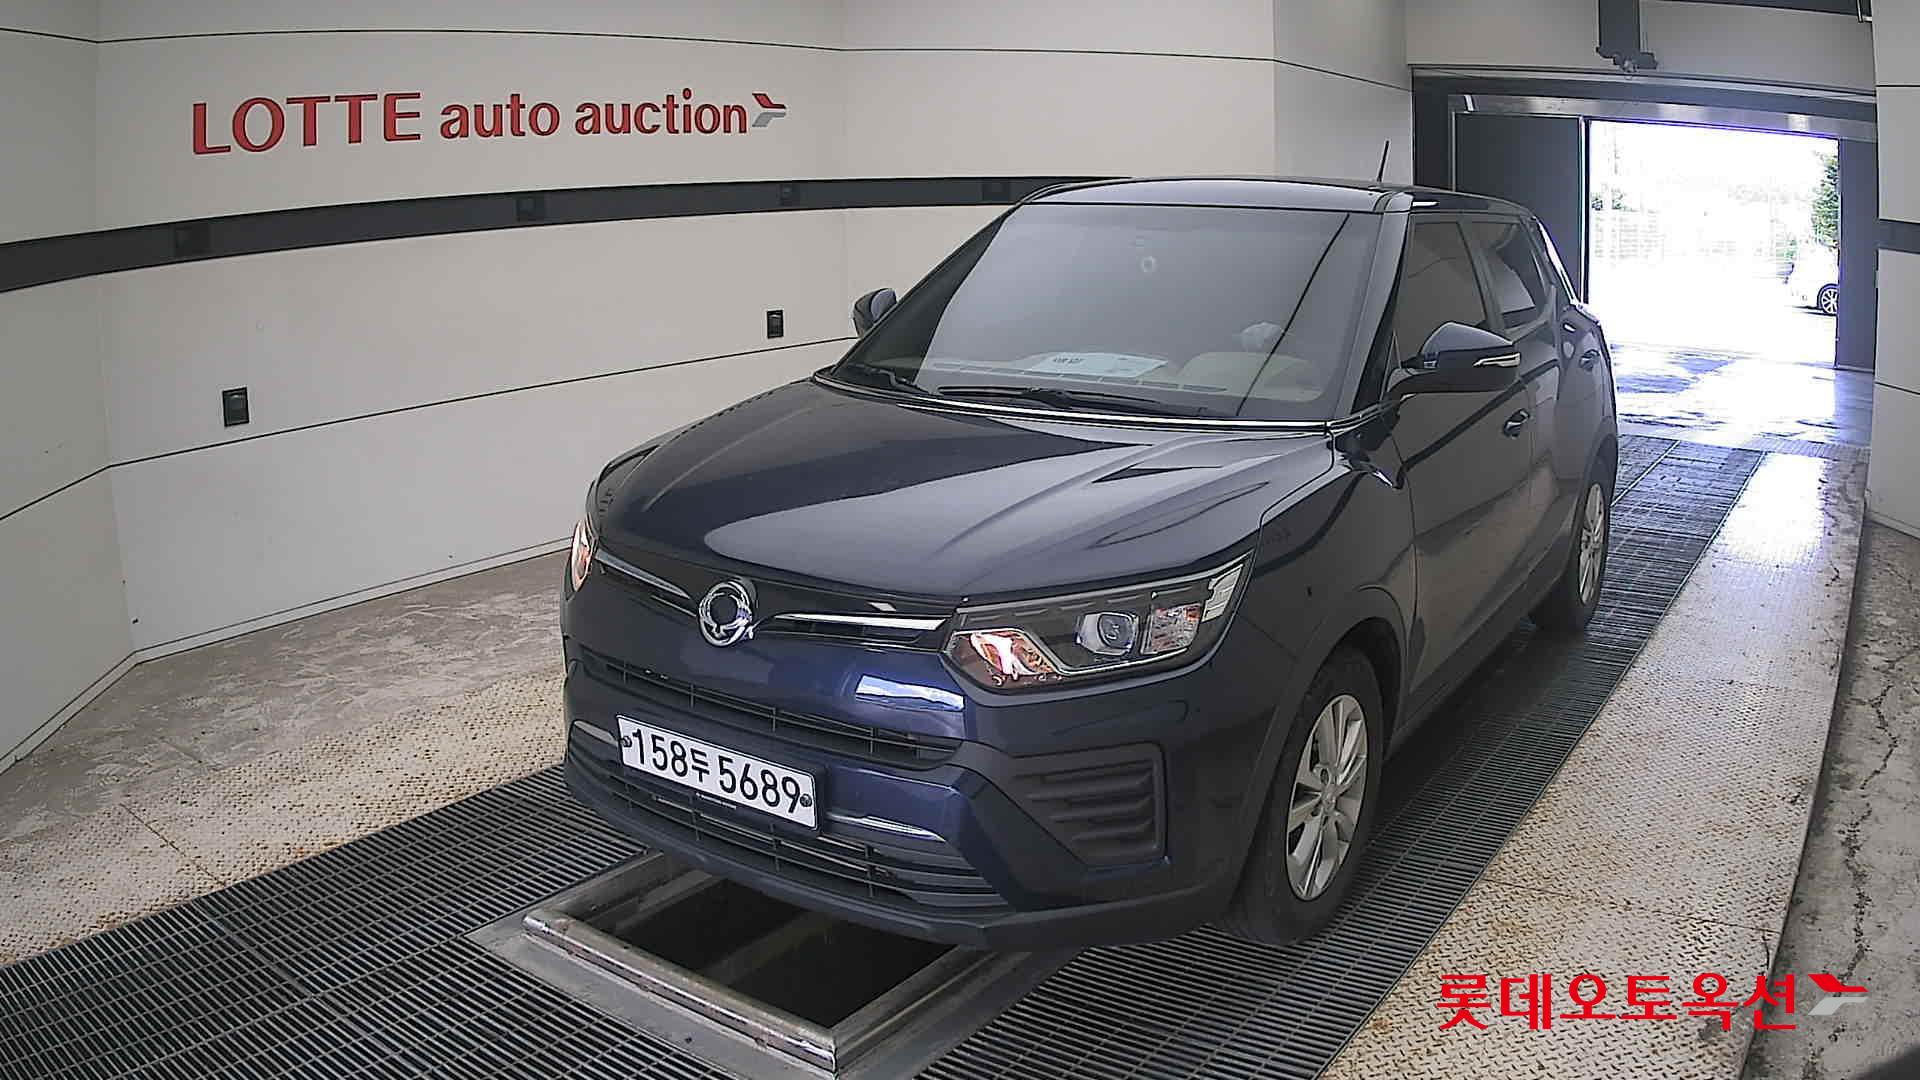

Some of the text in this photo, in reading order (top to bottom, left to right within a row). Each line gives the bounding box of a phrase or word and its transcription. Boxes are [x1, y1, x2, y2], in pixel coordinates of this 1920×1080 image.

[193, 88, 748, 155] LOTTE auto auction
